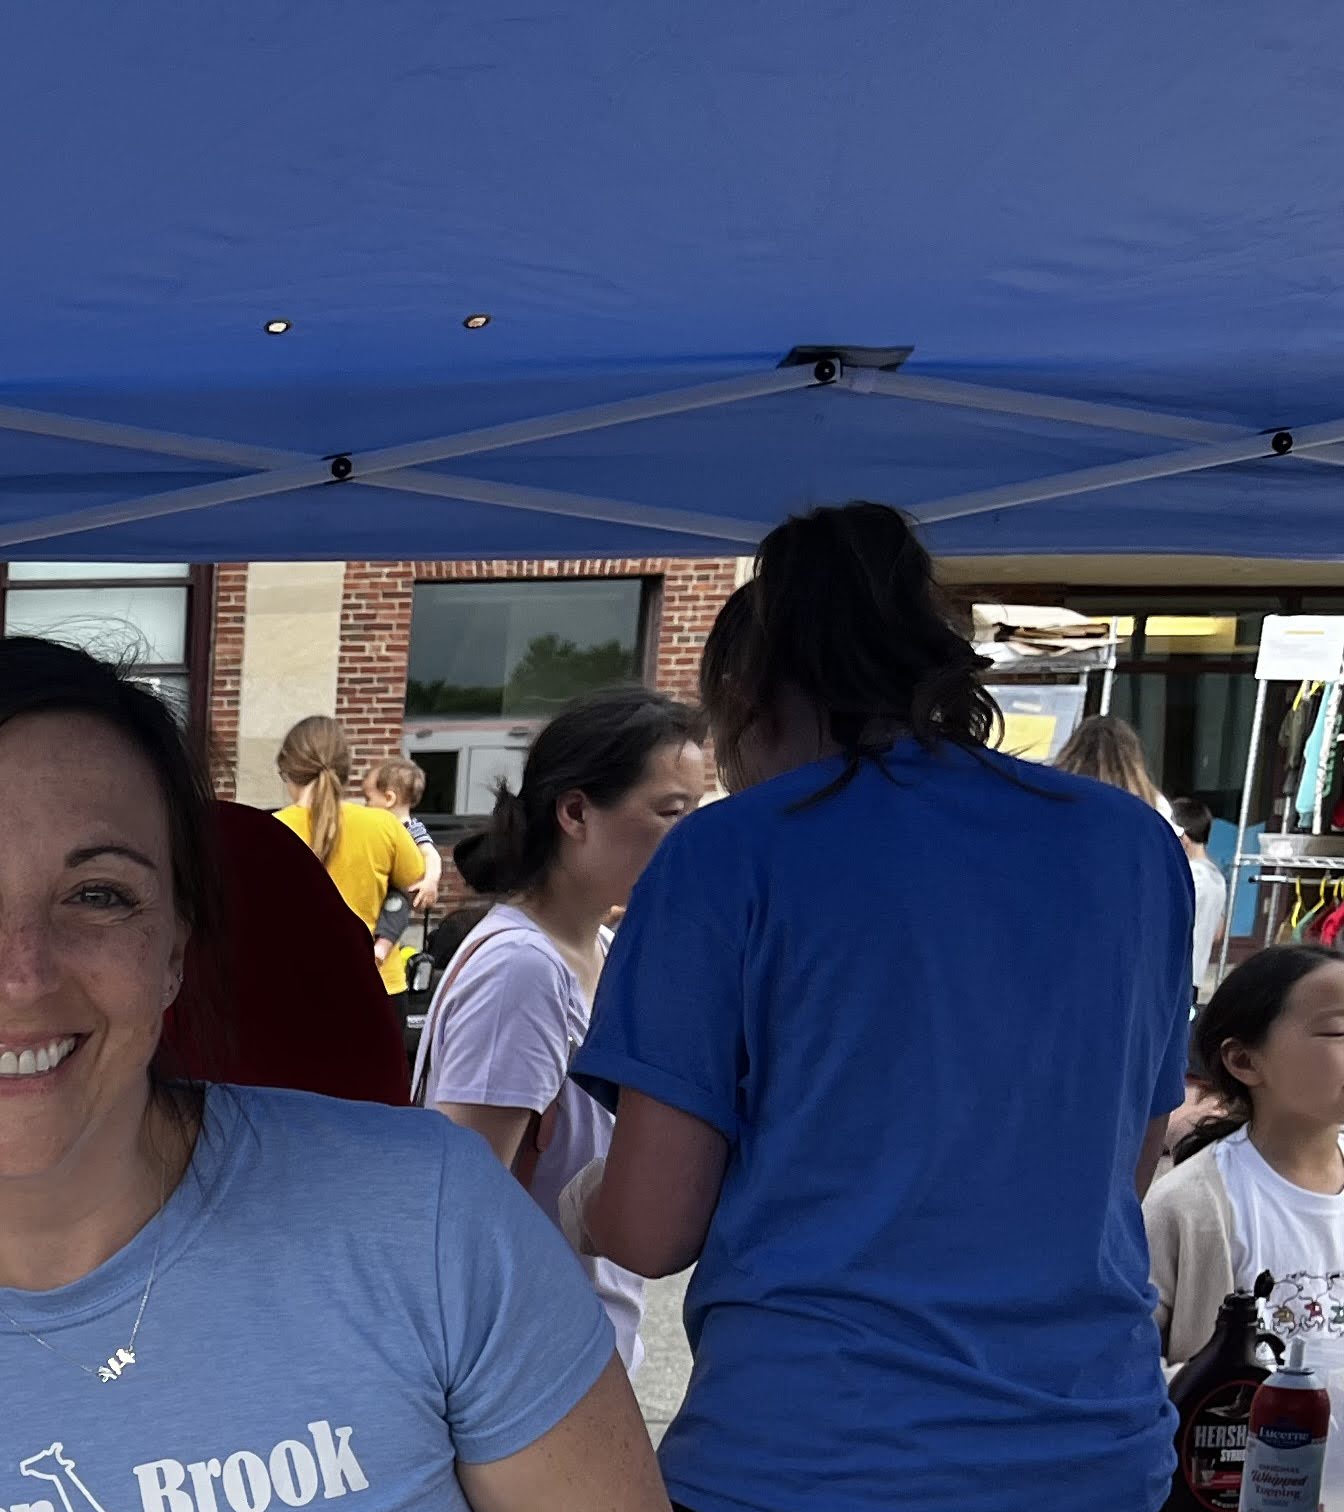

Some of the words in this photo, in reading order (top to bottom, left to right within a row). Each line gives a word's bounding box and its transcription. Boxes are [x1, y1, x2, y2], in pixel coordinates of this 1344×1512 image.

[1194, 1424, 1249, 1448] HERSH
[1220, 1449, 1246, 1462] SYRU
[1251, 1470, 1309, 1487] Whipped
